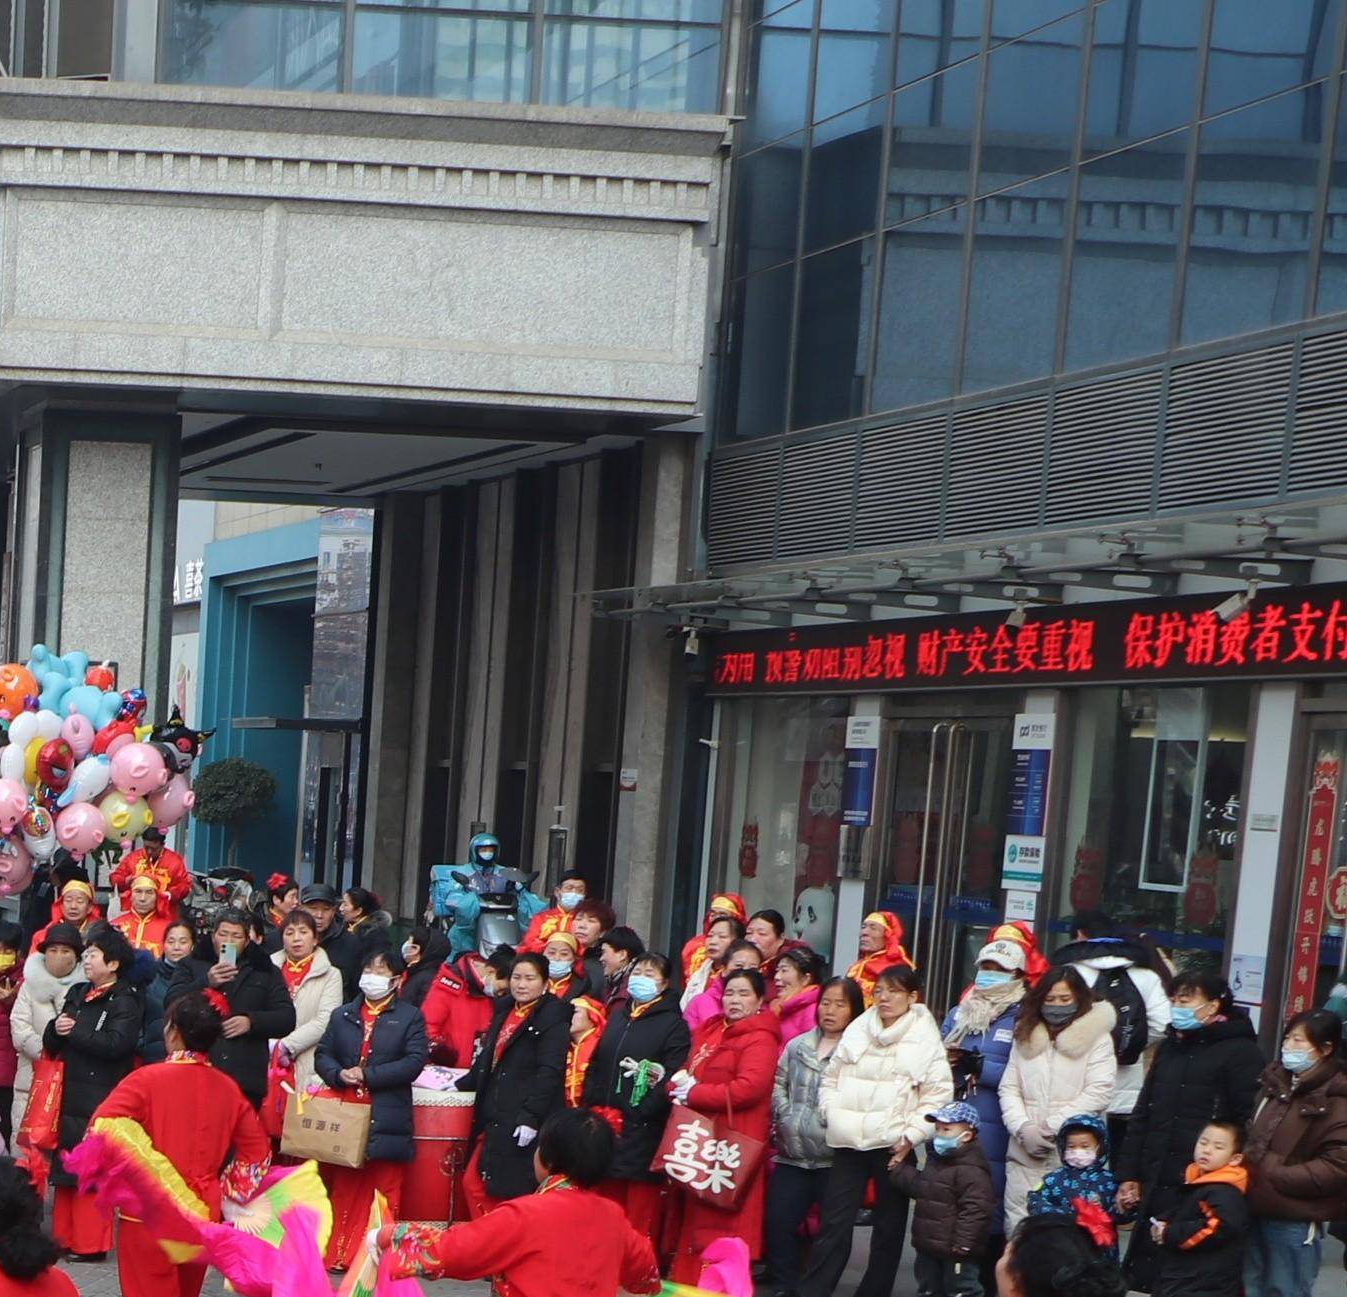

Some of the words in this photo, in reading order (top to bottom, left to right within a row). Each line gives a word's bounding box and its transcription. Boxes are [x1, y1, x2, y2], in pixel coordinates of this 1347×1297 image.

[916, 619, 1095, 677] 财产安全要重视
[663, 1119, 741, 1194] 喜樂
